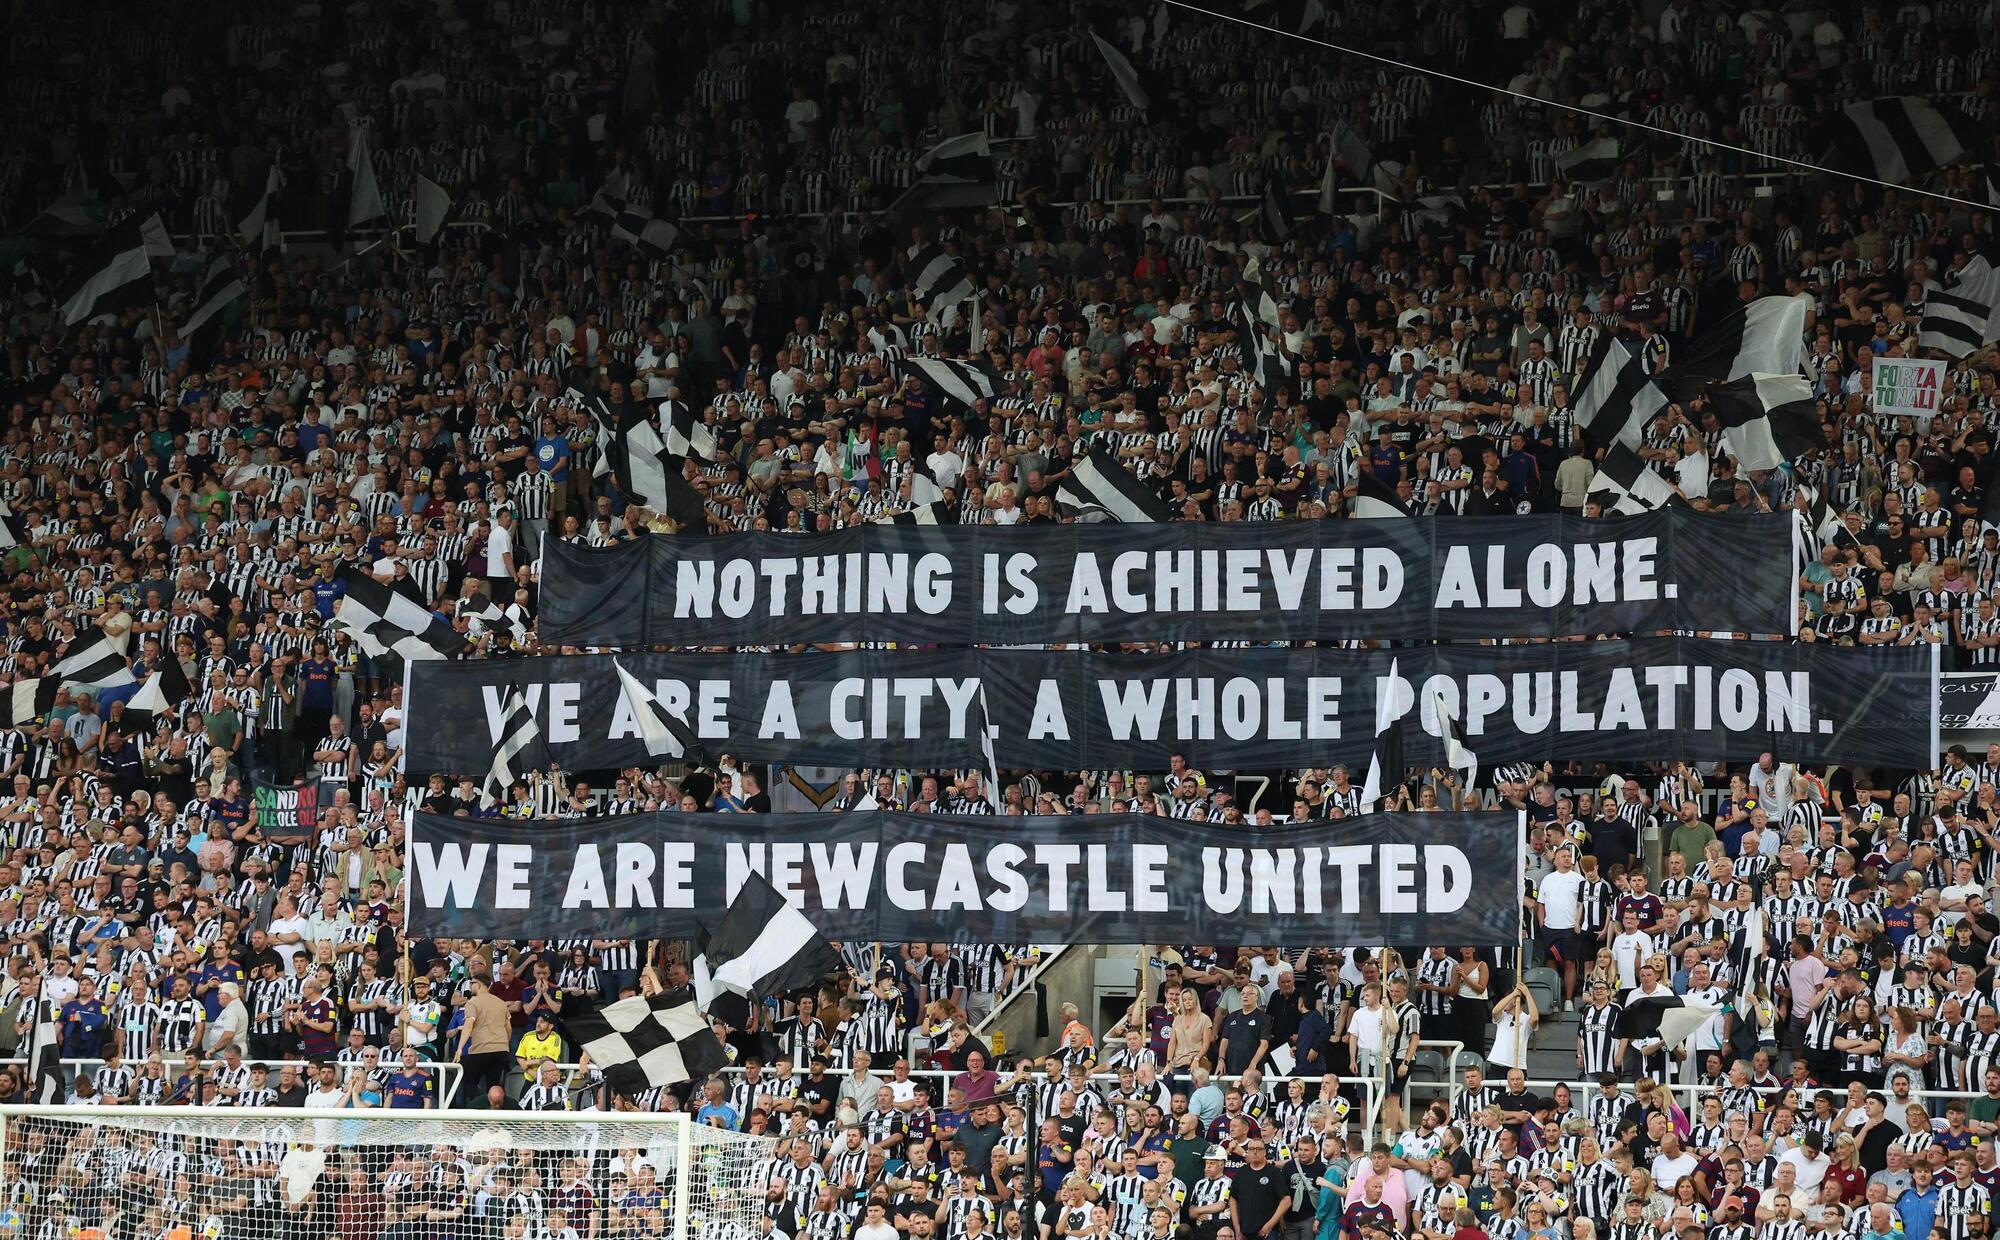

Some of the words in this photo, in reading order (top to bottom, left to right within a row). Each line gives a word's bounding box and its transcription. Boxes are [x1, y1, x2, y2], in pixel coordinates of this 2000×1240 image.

[1878, 365, 1937, 389] FORZA
[1876, 387, 1935, 410] TONALI
[674, 552, 952, 618] NOTHING
[983, 553, 1038, 614] IS
[1065, 548, 1404, 613] ACHIEVED
[1435, 537, 1677, 608] ALONE.
[482, 683, 580, 748] WE
[608, 679, 730, 739] ARE
[759, 681, 800, 739] A
[830, 678, 999, 740] CITY.
[1028, 680, 1070, 740] A
[1098, 677, 1341, 740] WHOLE
[1375, 666, 1833, 737] POPULATION.
[255, 786, 318, 810] SANDRO
[229, 810, 243, 818] sela
[256, 810, 277, 827] OLE
[277, 809, 298, 827] OLE
[298, 809, 317, 826] OLE
[413, 842, 532, 909] WE
[562, 842, 694, 909] ARE
[726, 842, 1168, 911] NEWCASTLE
[1202, 844, 1472, 914] UNITED
[1893, 919, 1909, 927] sela
[400, 1088, 414, 1096] sela
[1605, 1116, 1620, 1124] sela
[874, 1125, 889, 1133] sela
[1580, 1177, 1594, 1186] sela
[793, 1184, 808, 1192] sela
[1955, 1206, 1971, 1214] sela
[818, 1228, 832, 1236] sela
